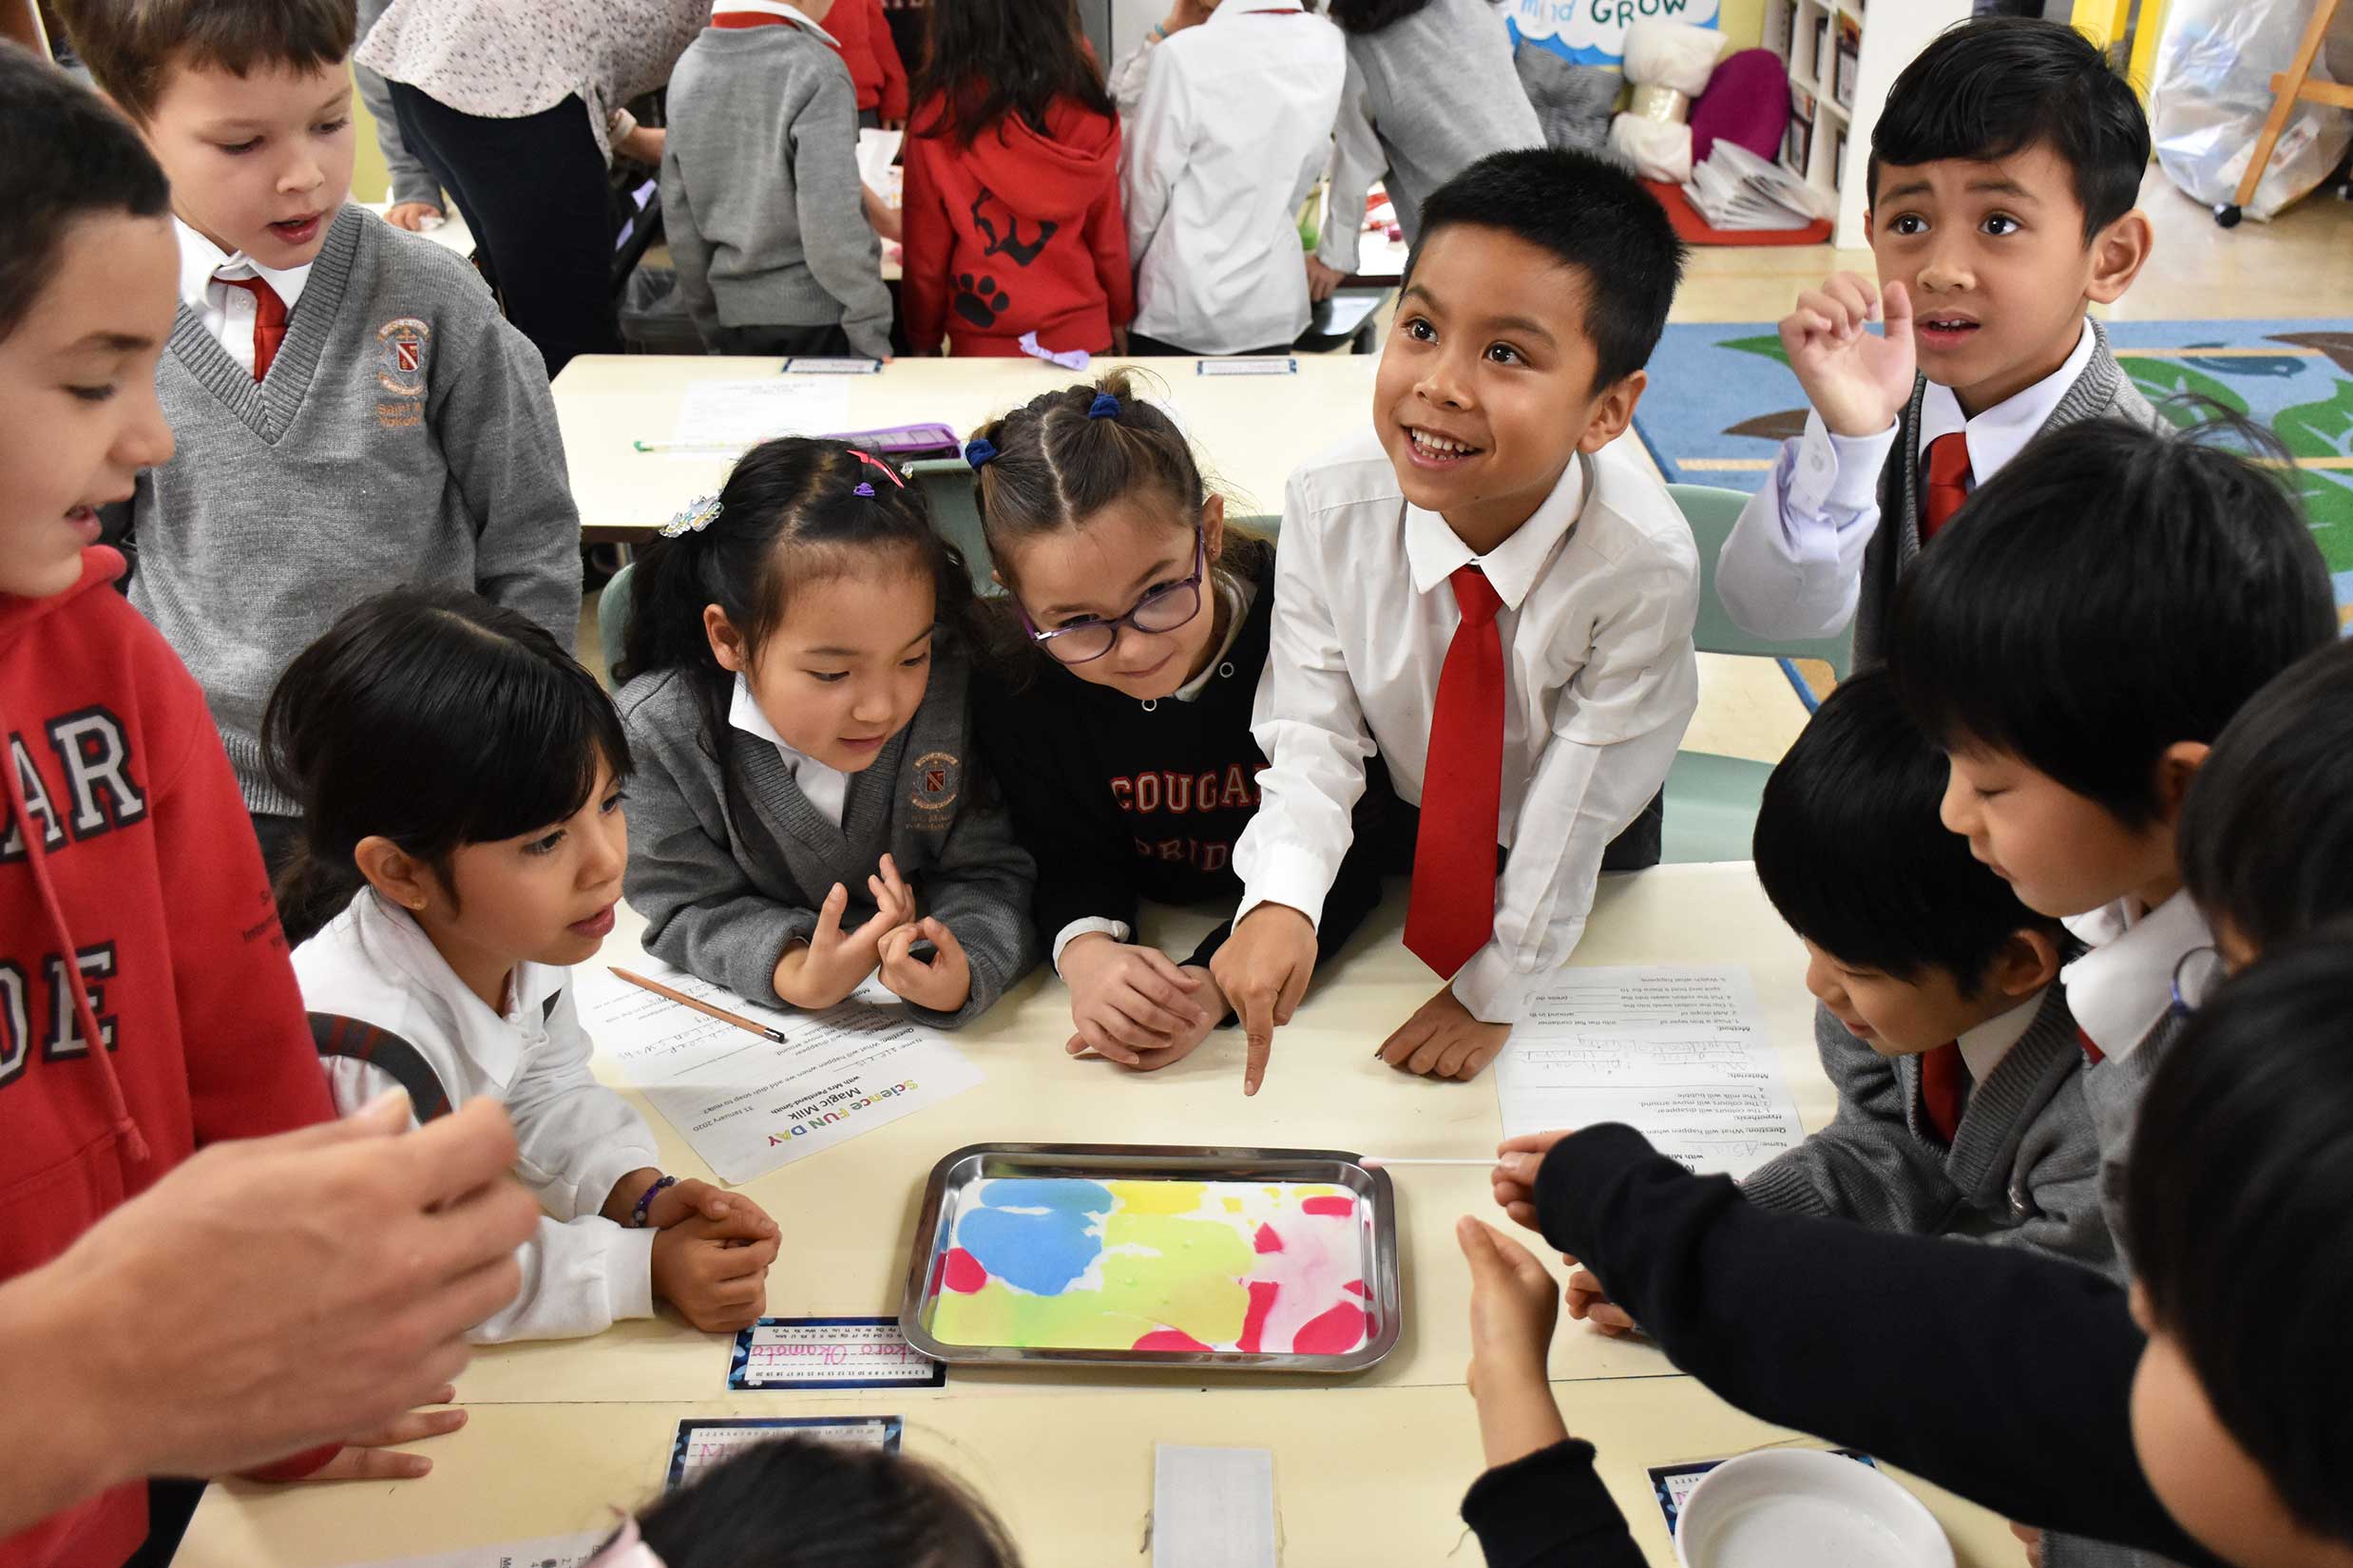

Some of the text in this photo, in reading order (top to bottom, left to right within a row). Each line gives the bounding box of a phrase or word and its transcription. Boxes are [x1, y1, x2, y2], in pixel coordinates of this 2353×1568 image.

[1134, 835, 1233, 874] PRID
[880, 1028, 913, 1043] Question:
[860, 1042, 880, 1052] What
[819, 1056, 846, 1067] happen
[797, 1067, 816, 1077] when
[770, 1080, 783, 1089] add
[754, 1086, 768, 1095] dish
[771, 1076, 860, 1115] with Mrs Pentland-Smith
[734, 1093, 752, 1101] soap
[788, 1087, 861, 1120] Magic Milk
[768, 1080, 918, 1147] Science FUN DAY
[693, 1120, 713, 1131] 2020
[752, 1345, 847, 1366] Okamoto
